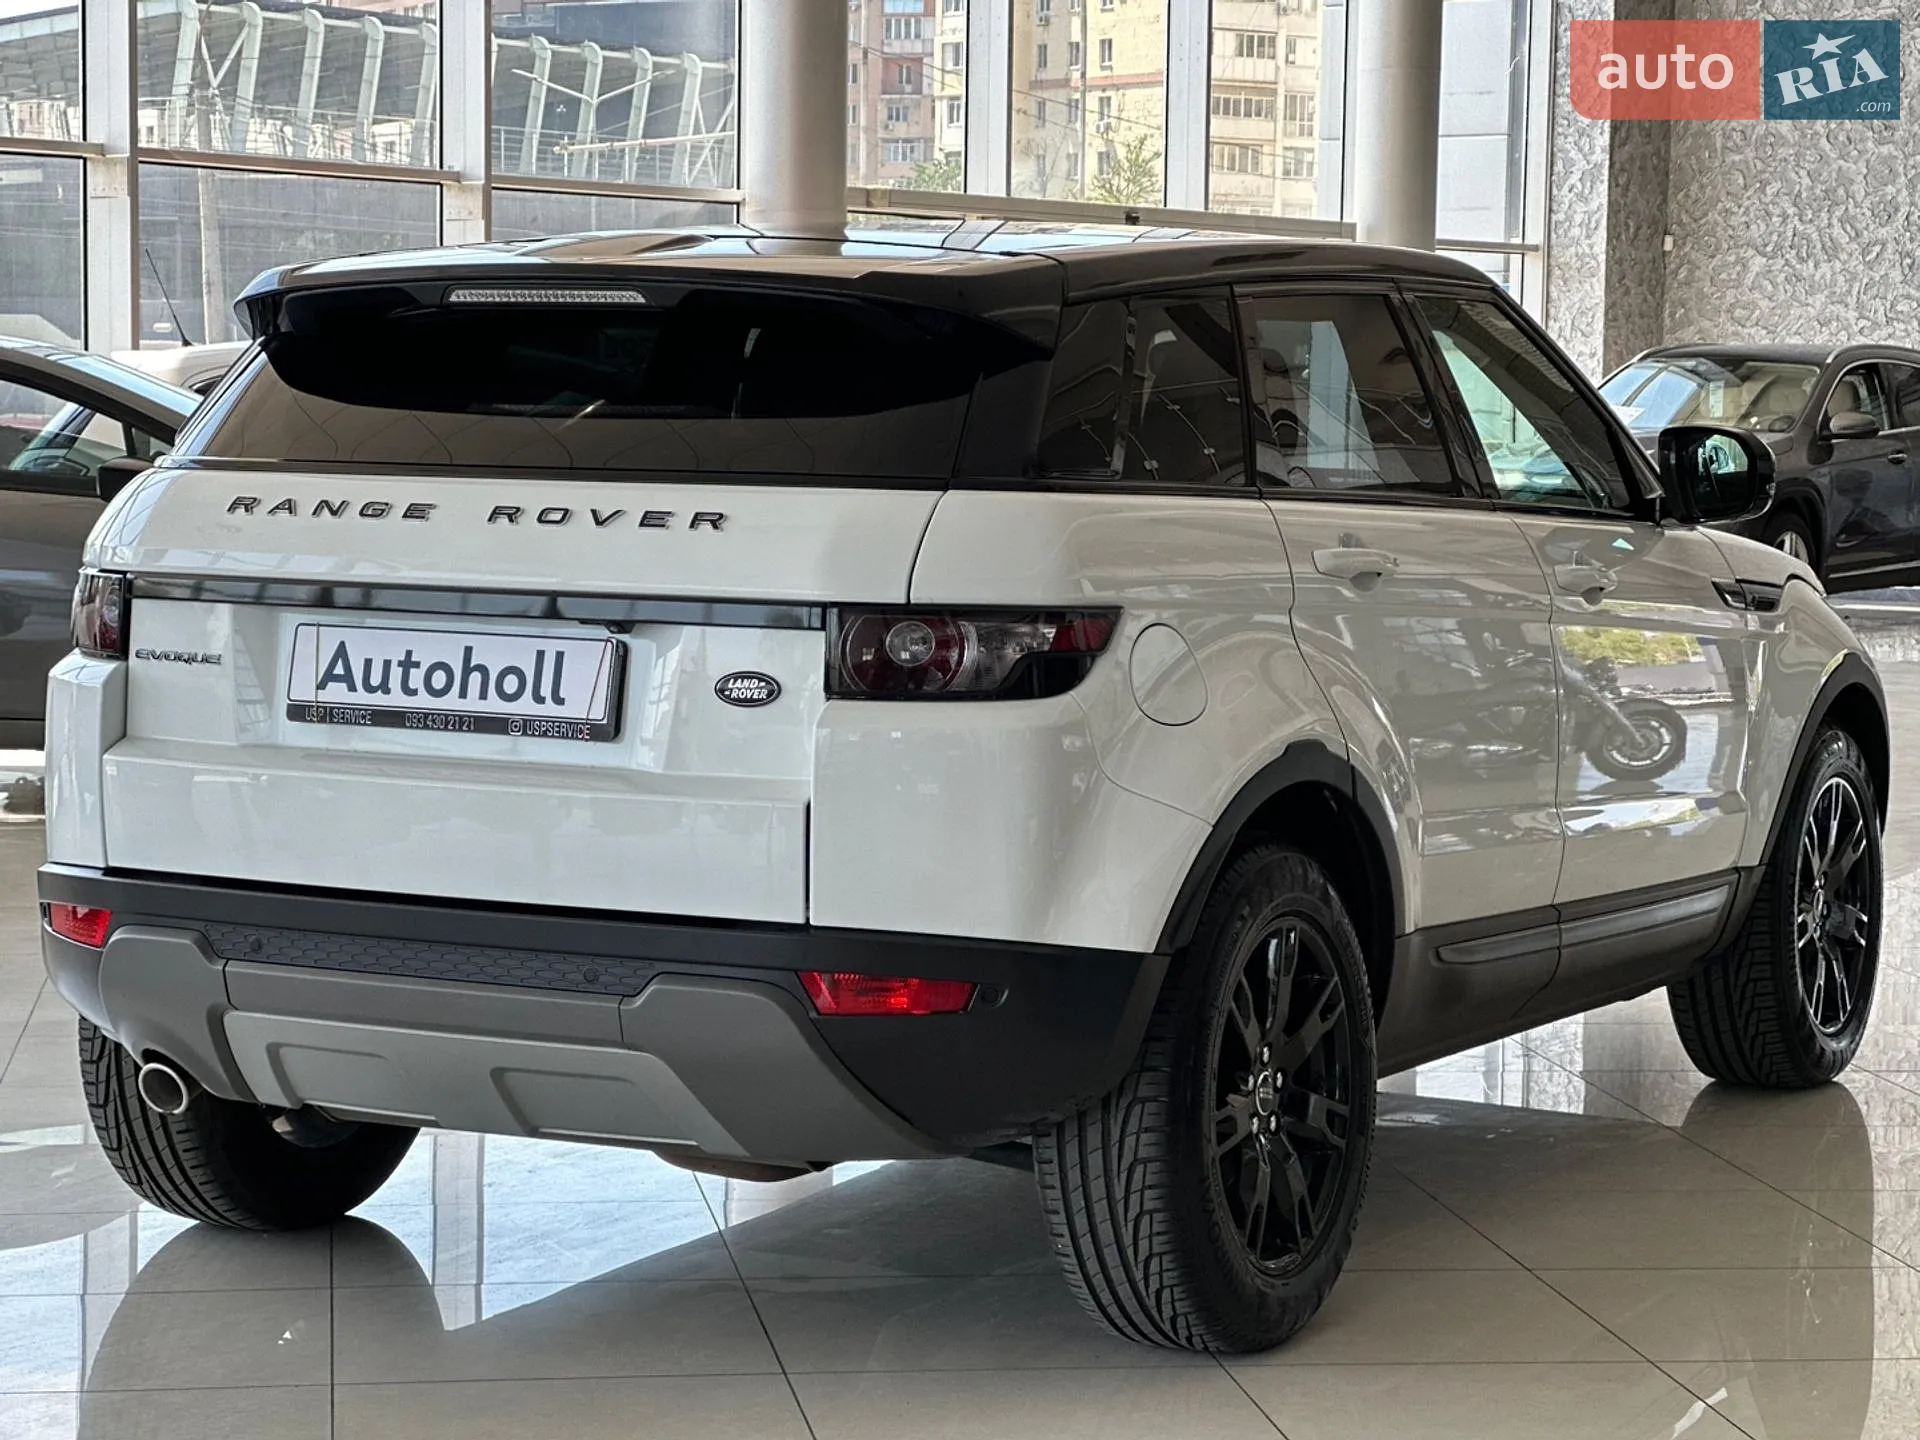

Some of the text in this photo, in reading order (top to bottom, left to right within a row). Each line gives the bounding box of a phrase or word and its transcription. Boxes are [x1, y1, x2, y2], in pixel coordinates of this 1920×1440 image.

[227, 496, 727, 532] RANGE ROVER
[135, 648, 222, 665] EVOQUE
[317, 640, 566, 706] Autoholl
[305, 707, 324, 721] USP
[332, 709, 373, 724] SERVICE
[405, 713, 475, 731] 093 430 21 21
[526, 720, 591, 739] USPSERVICE
